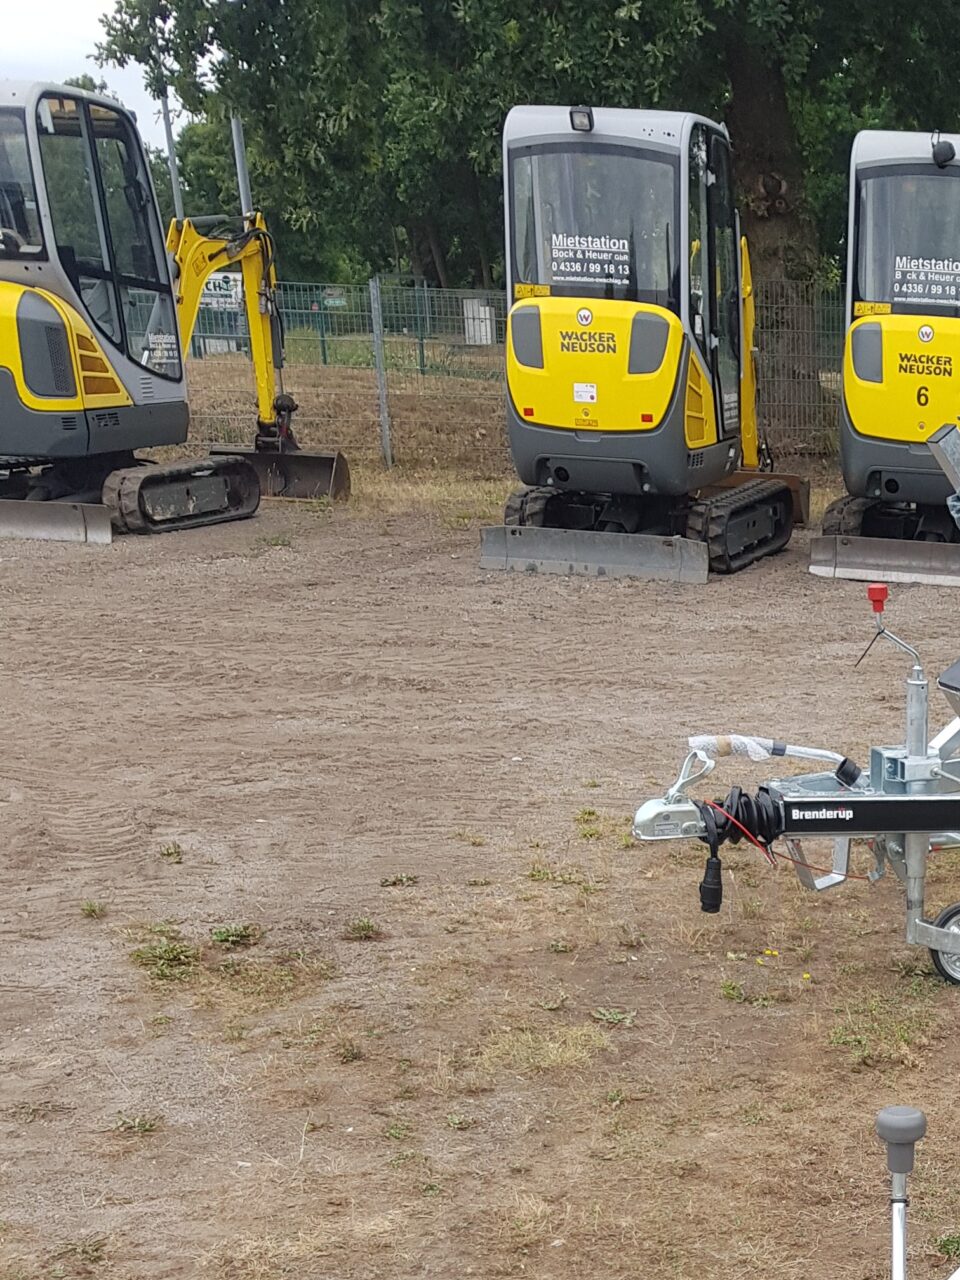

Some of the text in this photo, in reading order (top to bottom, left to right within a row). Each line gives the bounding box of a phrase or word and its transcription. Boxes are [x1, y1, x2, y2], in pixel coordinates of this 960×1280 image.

[552, 234, 628, 250] Mietstation
[553, 249, 574, 258] Bock
[576, 250, 583, 259] &
[585, 250, 612, 260] Heuer
[552, 263, 557, 271] 0
[559, 262, 581, 272] 4336
[589, 263, 600, 273] 99
[603, 264, 615, 274] 18
[618, 265, 629, 274] 13
[919, 271, 926, 280] &
[928, 272, 954, 282] Heuer
[894, 283, 899, 292] 0
[901, 283, 923, 293] 4336
[931, 284, 942, 294] 99
[945, 285, 956, 295] 18
[560, 331, 616, 342] WACKER
[560, 342, 617, 354] NEUSON
[899, 353, 953, 366] WACKER
[898, 364, 952, 377] NEUSON
[917, 386, 929, 406] 6
[792, 808, 854, 820] Brenderup
